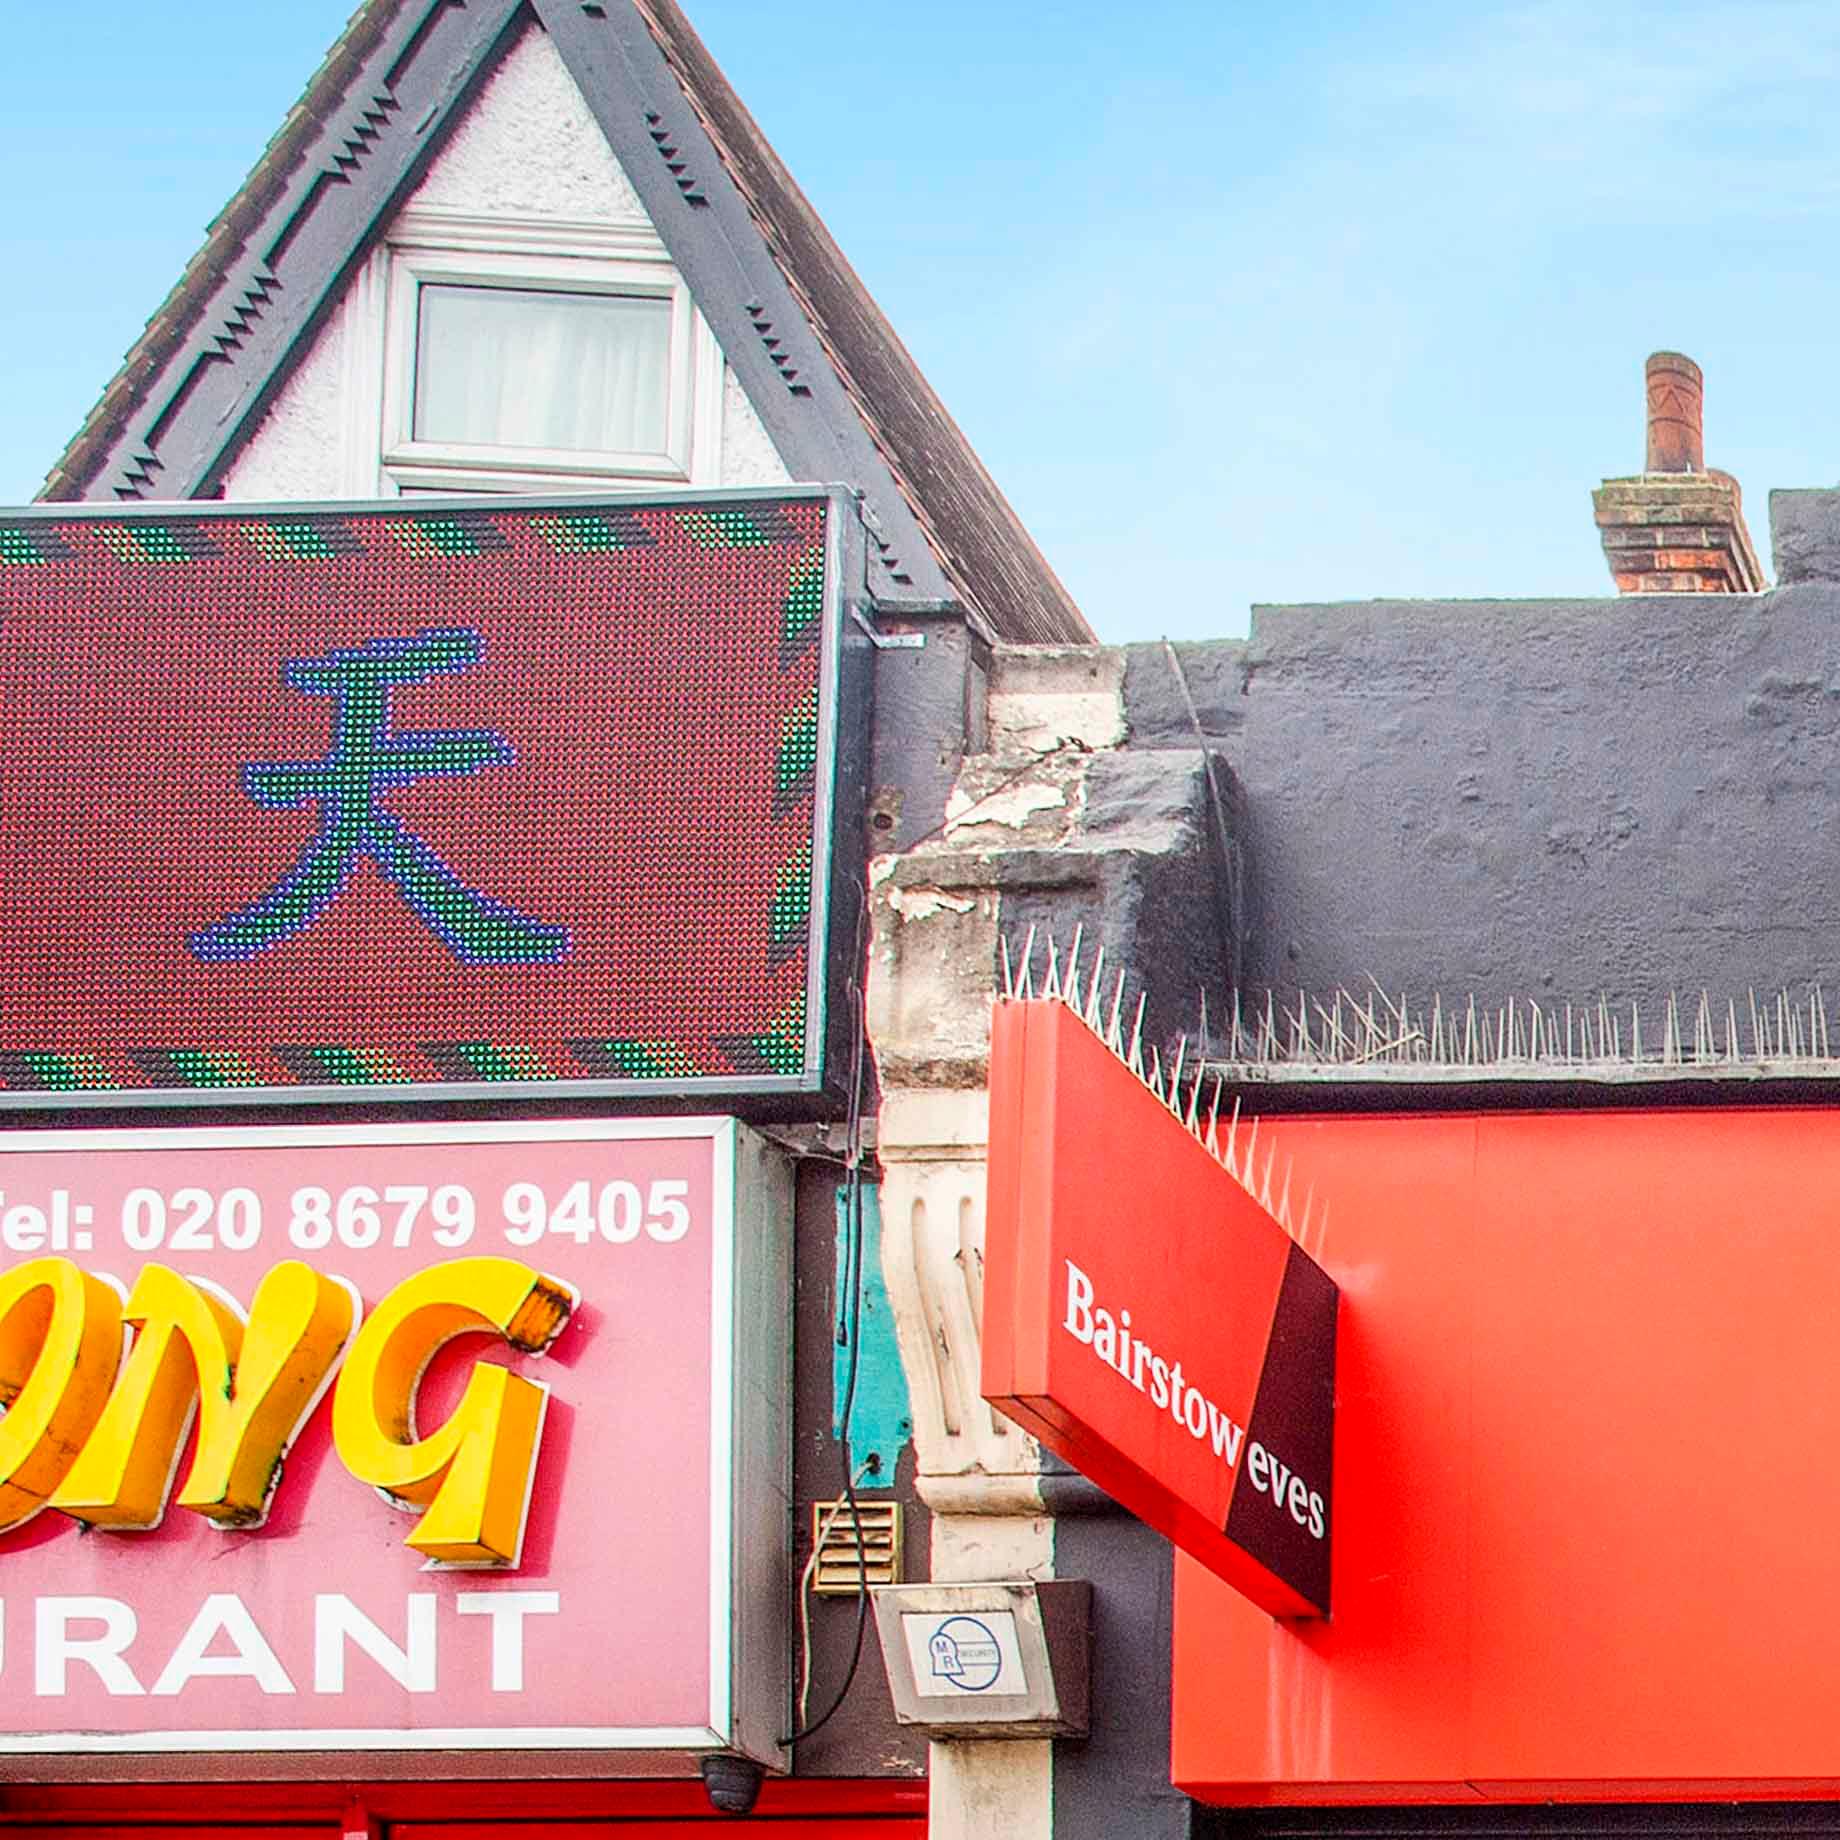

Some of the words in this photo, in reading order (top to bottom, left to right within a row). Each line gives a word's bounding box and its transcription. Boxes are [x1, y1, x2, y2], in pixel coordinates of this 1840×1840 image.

[190, 627, 574, 966] 天
[0, 1187, 94, 1251] el:
[121, 1188, 262, 1251] 020
[288, 1184, 477, 1249] 8679
[503, 1179, 690, 1245] 9405
[1063, 1258, 1245, 1469] Bairstow
[1246, 1439, 1326, 1540] eves
[0, 1592, 560, 1697] RANT
